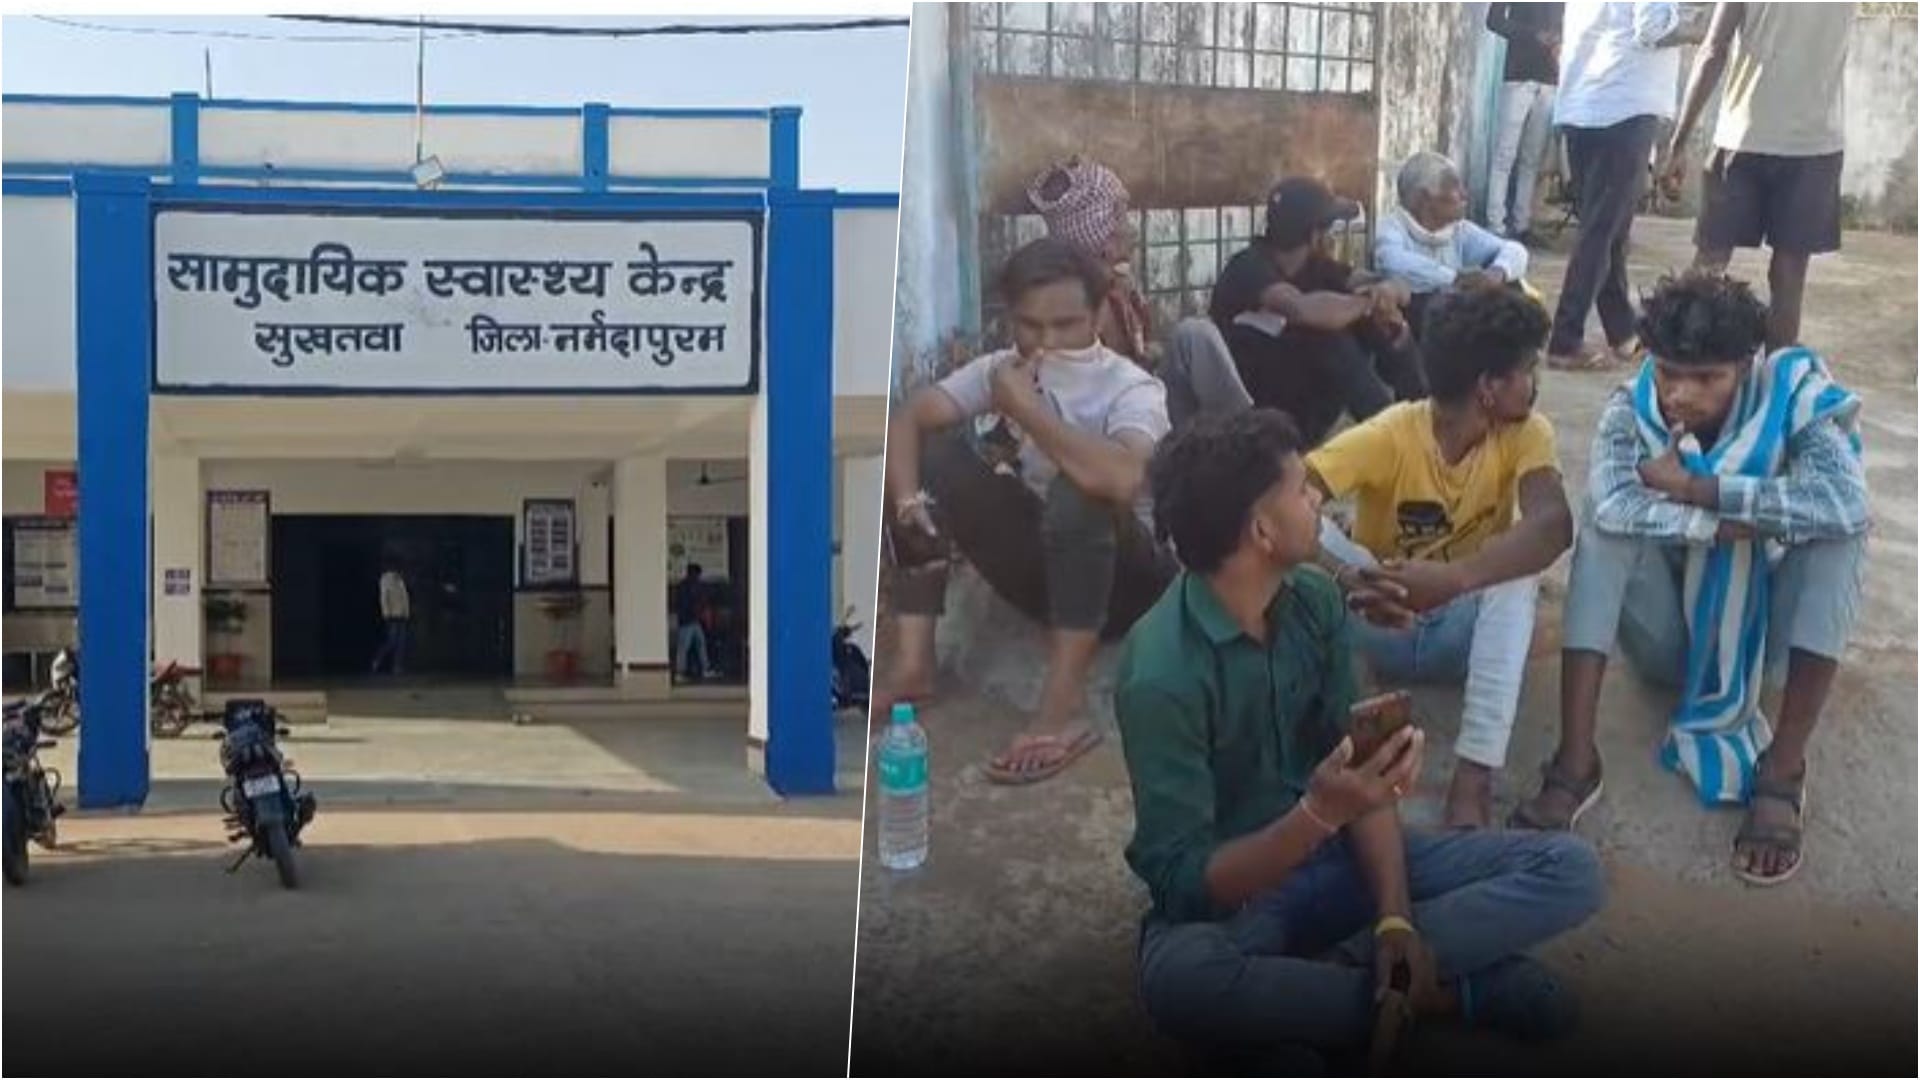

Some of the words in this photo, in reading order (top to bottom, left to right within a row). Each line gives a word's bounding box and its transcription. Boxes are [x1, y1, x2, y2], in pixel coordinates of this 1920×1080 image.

[167, 242, 408, 310] सामुदायिक
[627, 241, 734, 303] केन्द्र
[255, 322, 405, 368] सुखतवा
